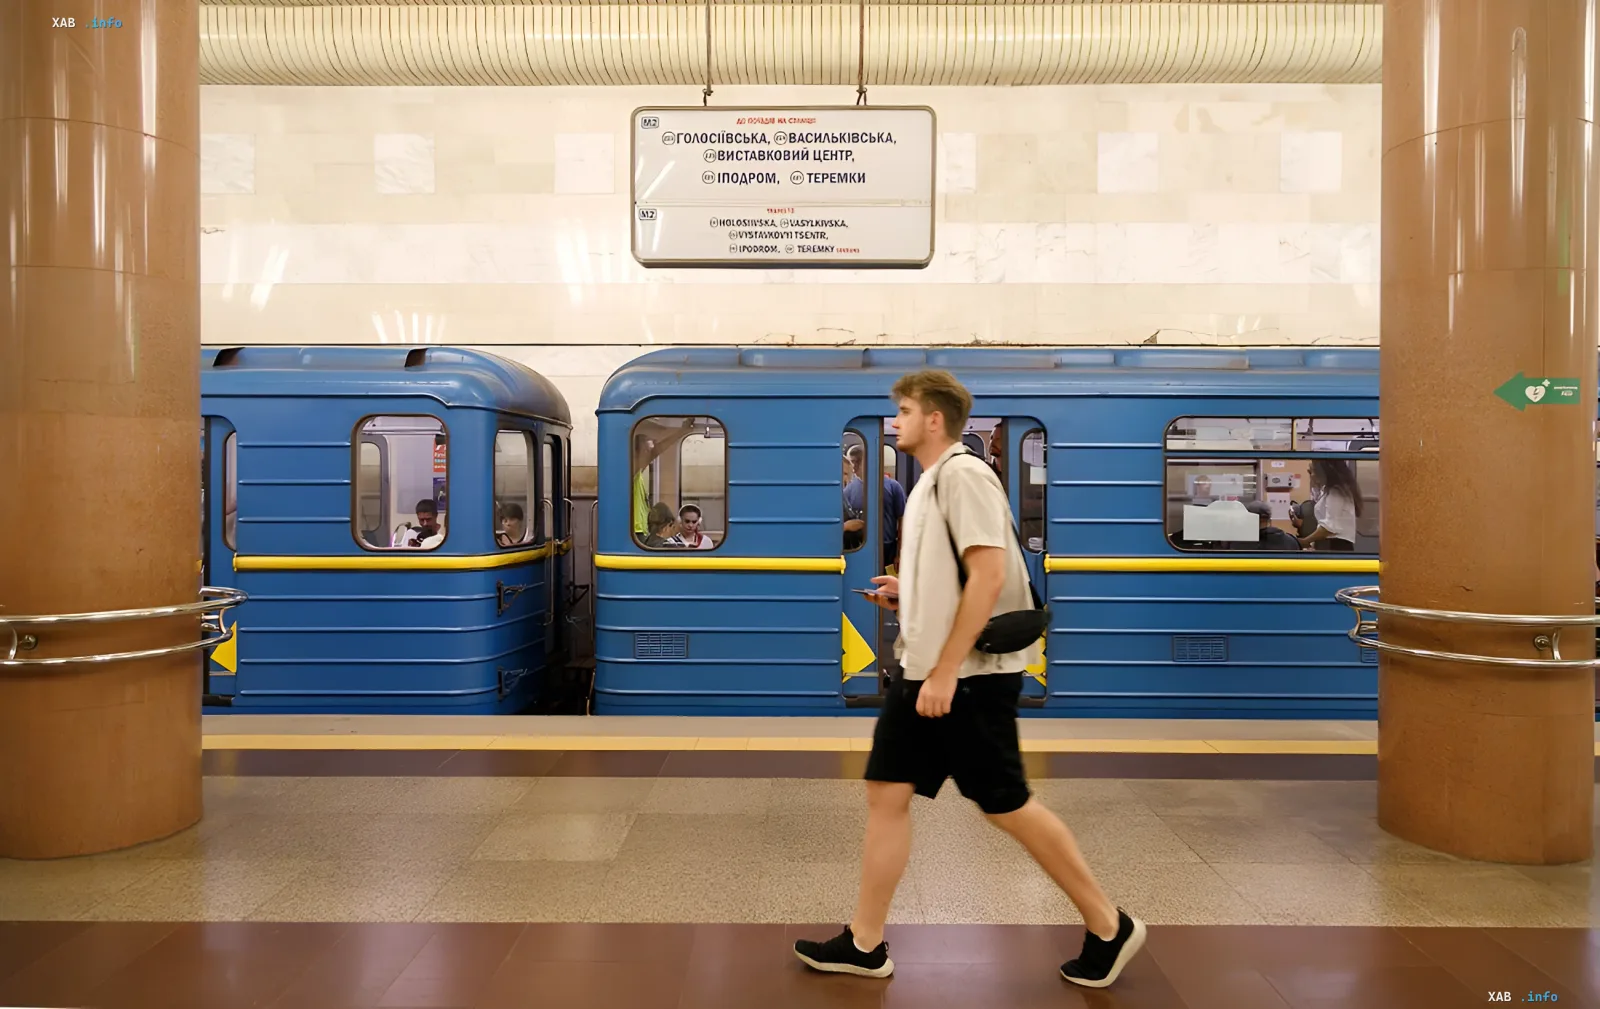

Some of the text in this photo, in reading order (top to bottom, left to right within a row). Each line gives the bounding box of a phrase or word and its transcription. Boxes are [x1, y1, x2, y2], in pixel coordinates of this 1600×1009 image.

[676, 130, 771, 145] ГОЛОСІЇВСЬКА,
[788, 131, 897, 145] ВАСИЛЬКІВСЬКА,
[717, 147, 809, 161] ВИСТАВКОВИЙ
[813, 149, 855, 162] ЦЕНТР,
[717, 172, 780, 185] ІПОДРОМ,
[806, 172, 866, 184] ТЕРЕМКИ
